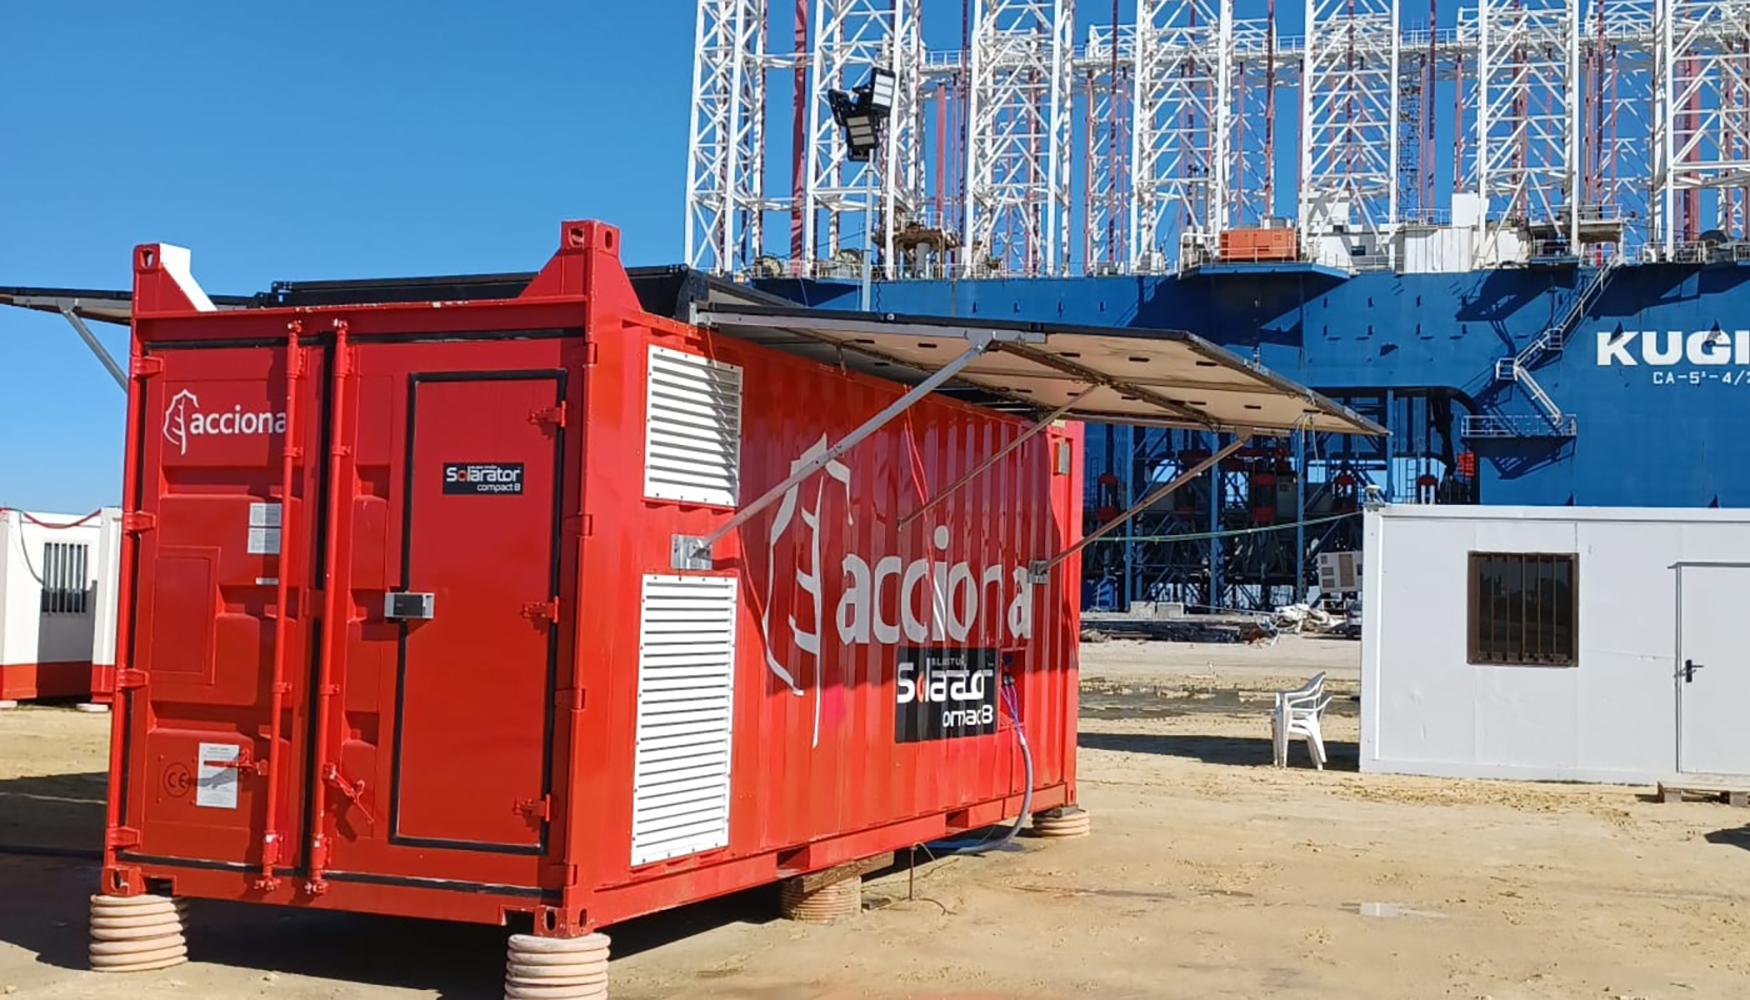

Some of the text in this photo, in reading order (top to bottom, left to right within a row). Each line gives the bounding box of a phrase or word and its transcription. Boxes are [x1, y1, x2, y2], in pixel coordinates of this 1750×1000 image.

[190, 404, 286, 435] acciona
[446, 465, 521, 482] Solarator
[477, 484, 513, 493] compact
[836, 525, 1033, 645] acciona
